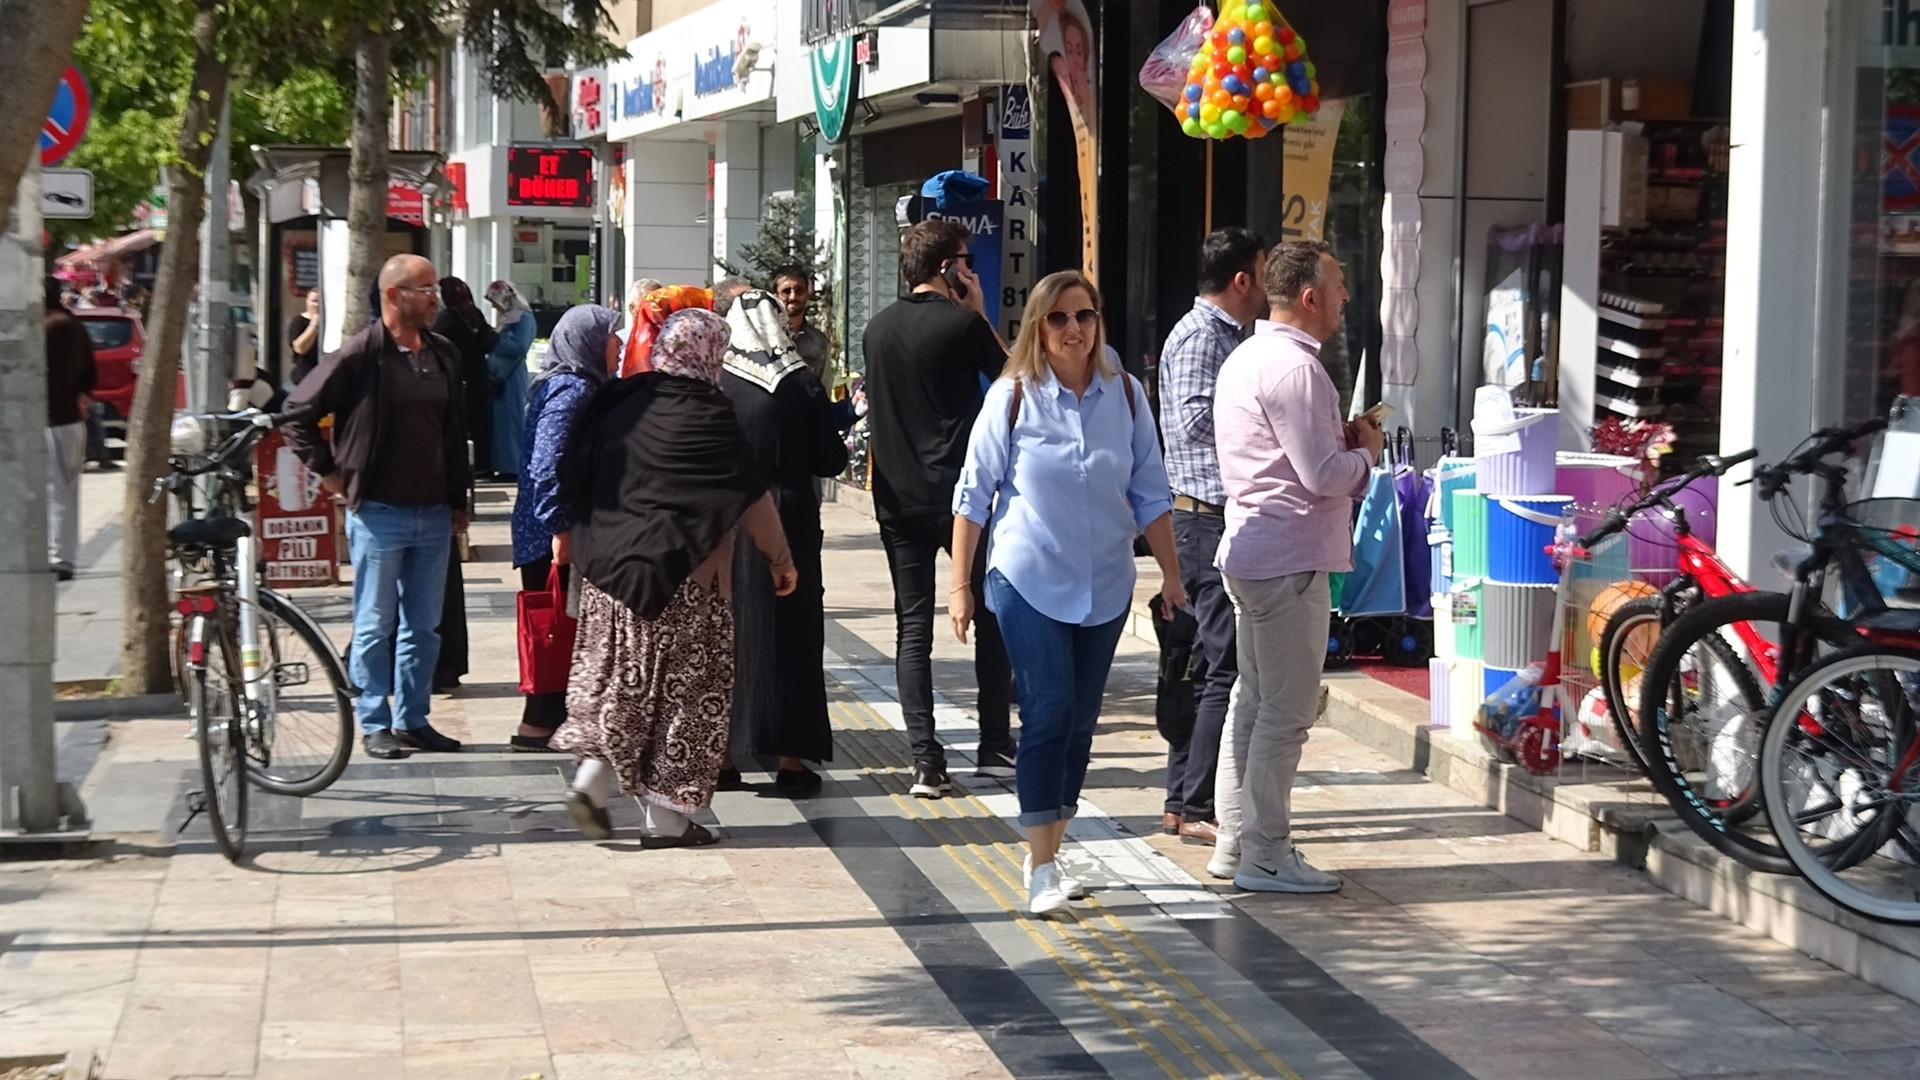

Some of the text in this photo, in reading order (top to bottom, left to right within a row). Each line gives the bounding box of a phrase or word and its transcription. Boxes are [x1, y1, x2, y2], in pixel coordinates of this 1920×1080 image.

[539, 155, 560, 175] ET
[519, 175, 579, 199] DÖNER
[1009, 151, 1026, 274] KART
